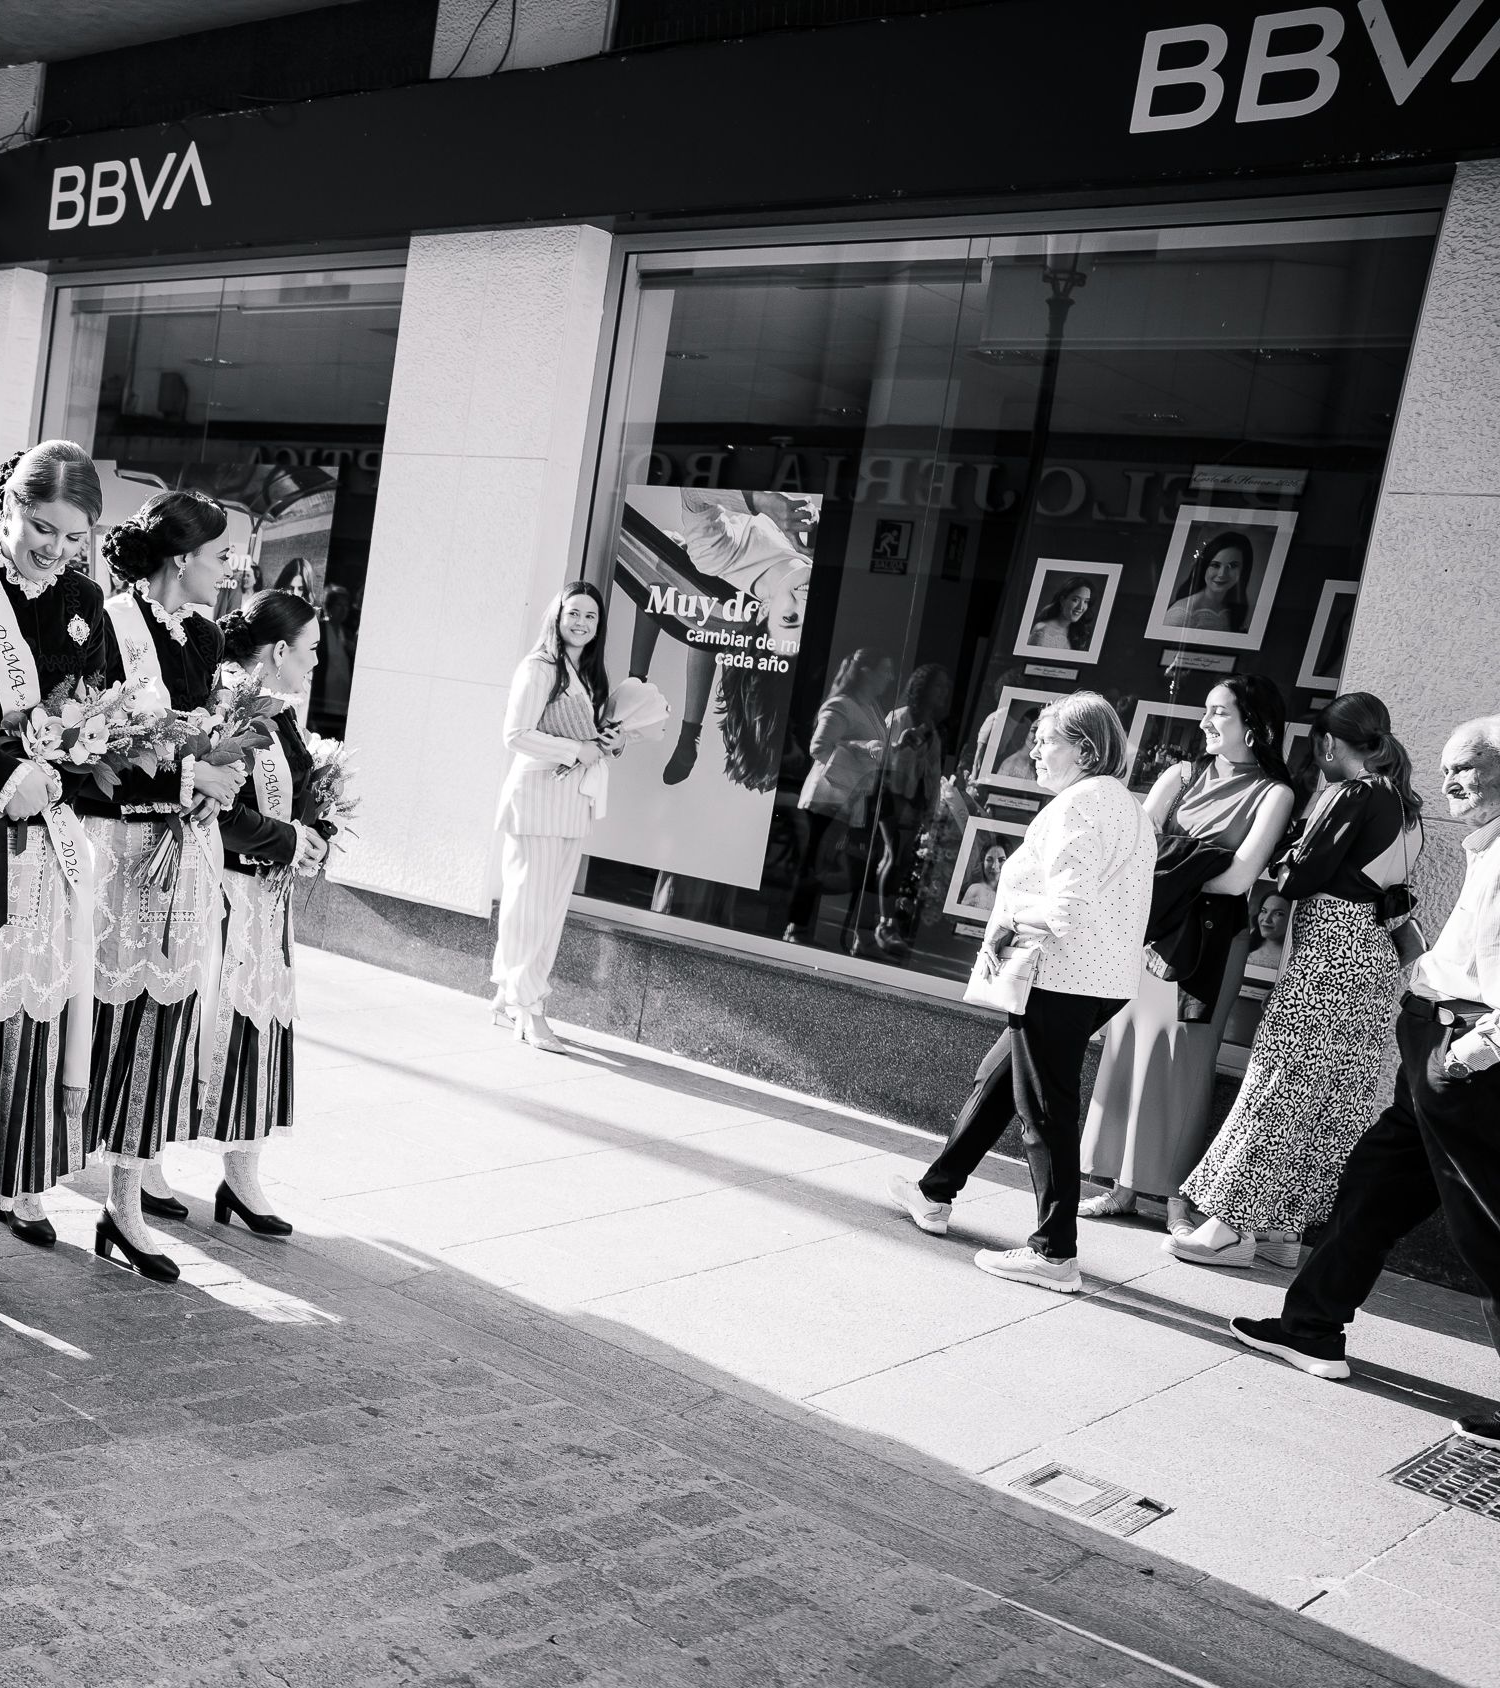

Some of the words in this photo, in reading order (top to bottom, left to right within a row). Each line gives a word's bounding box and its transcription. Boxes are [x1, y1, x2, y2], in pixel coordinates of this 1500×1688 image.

[47, 140, 212, 231] BBVA
[873, 561, 905, 570] SALIDA
[644, 585, 719, 627] Muy
[686, 628, 753, 648] cambiar
[756, 633, 777, 650] de
[714, 651, 754, 670] cada
[757, 656, 790, 673] año
[261, 759, 282, 811] DAMA
[60, 840, 80, 877] 2026
